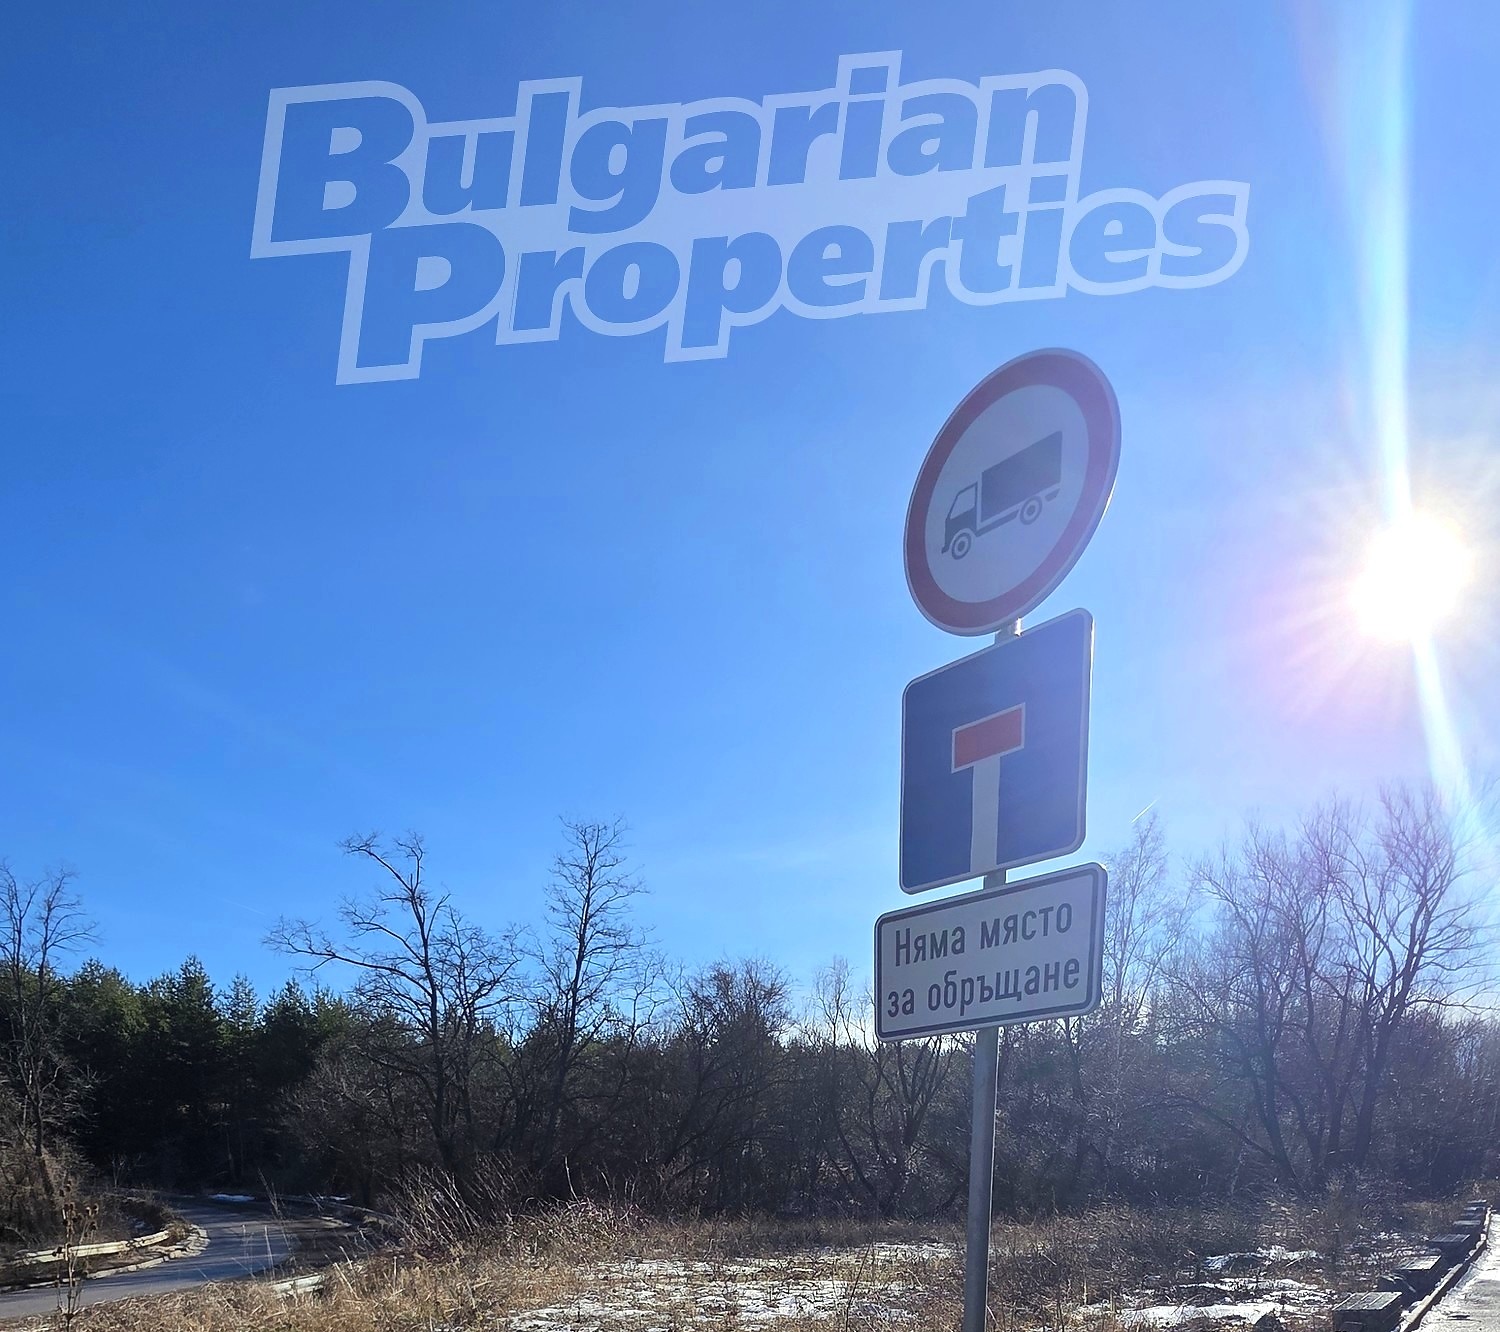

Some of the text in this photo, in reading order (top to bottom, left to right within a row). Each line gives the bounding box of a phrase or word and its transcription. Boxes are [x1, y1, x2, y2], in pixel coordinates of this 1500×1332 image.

[895, 903, 1072, 967] Няма място
[887, 958, 1080, 1018] за обръщане
